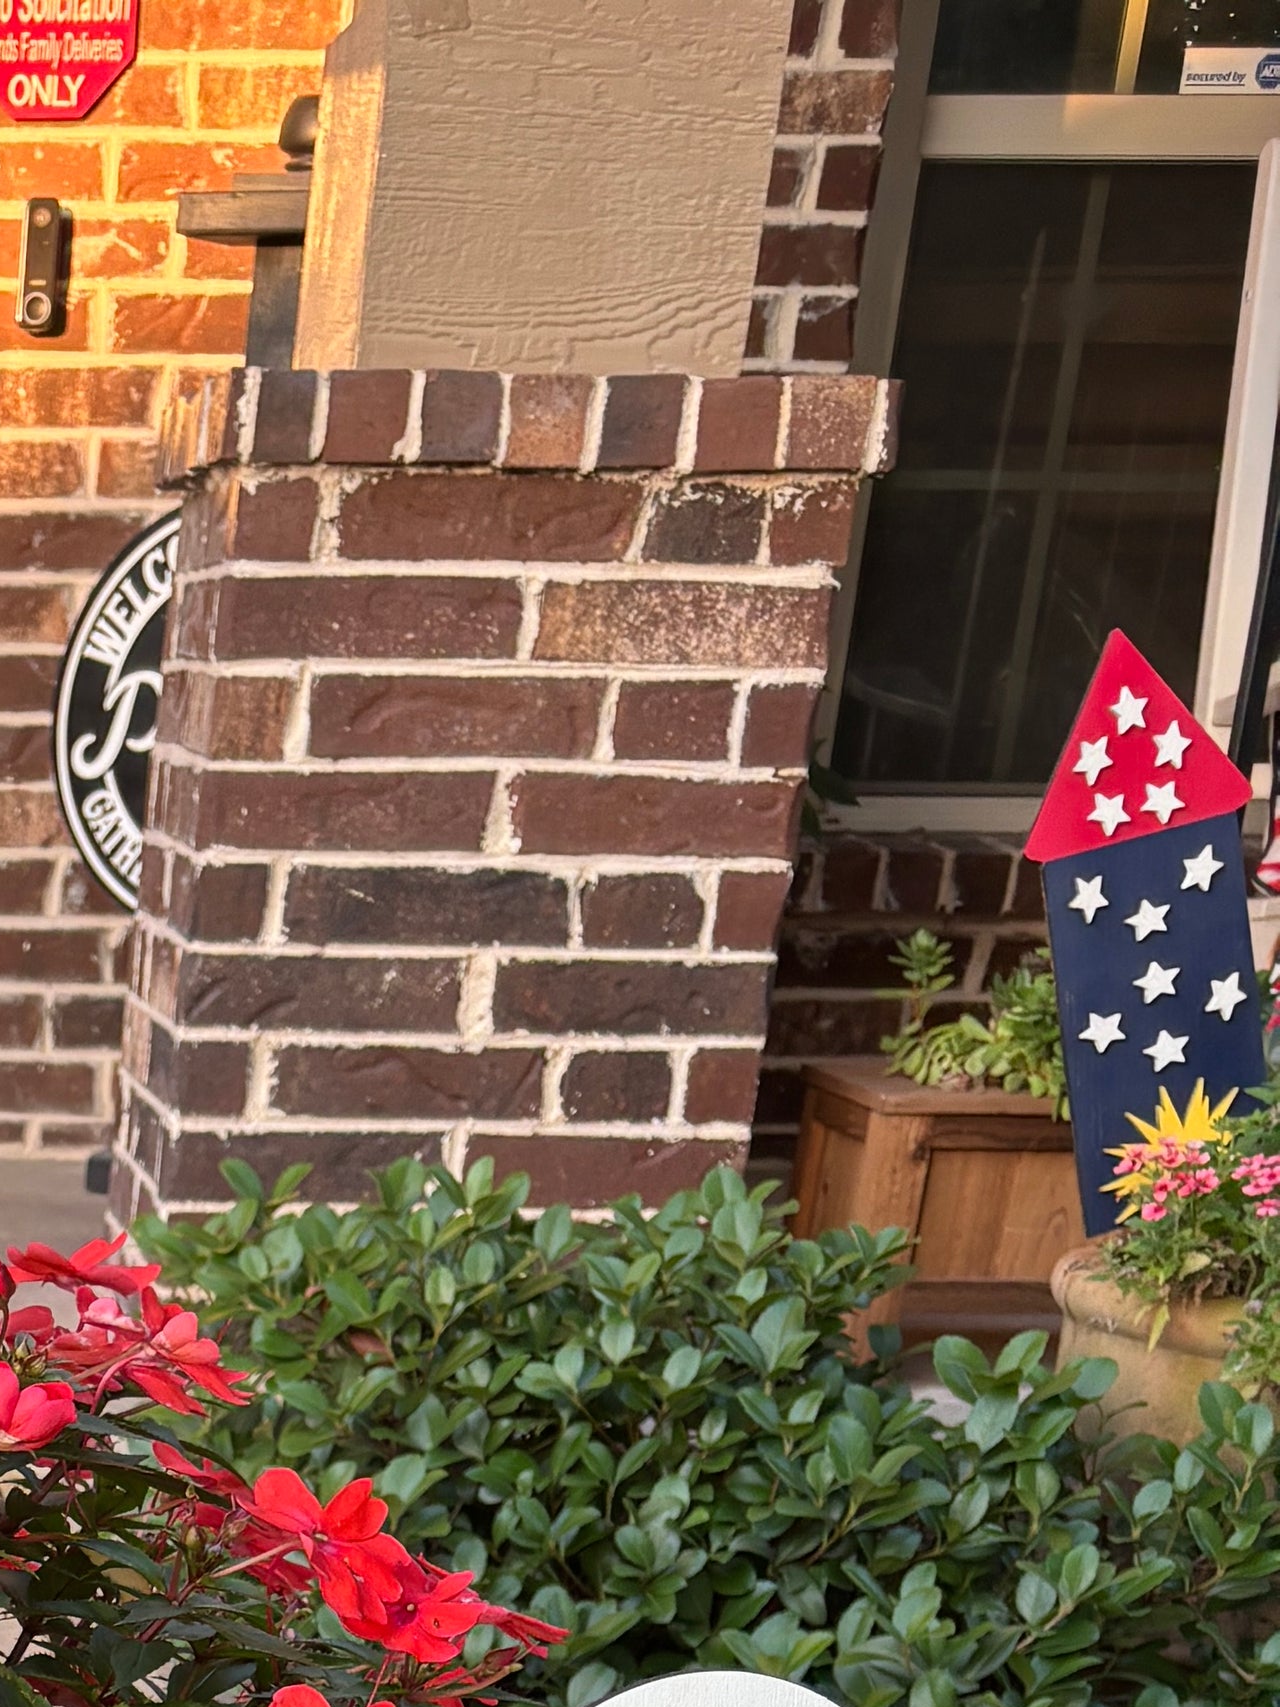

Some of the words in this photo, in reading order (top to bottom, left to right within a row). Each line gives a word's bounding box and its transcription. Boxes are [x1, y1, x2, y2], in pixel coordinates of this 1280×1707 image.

[17, 0, 131, 23] Solicitation
[19, 31, 62, 70] Family
[62, 31, 124, 62] Deliveries
[7, 73, 86, 107] ONLY
[1232, 71, 1247, 83] by
